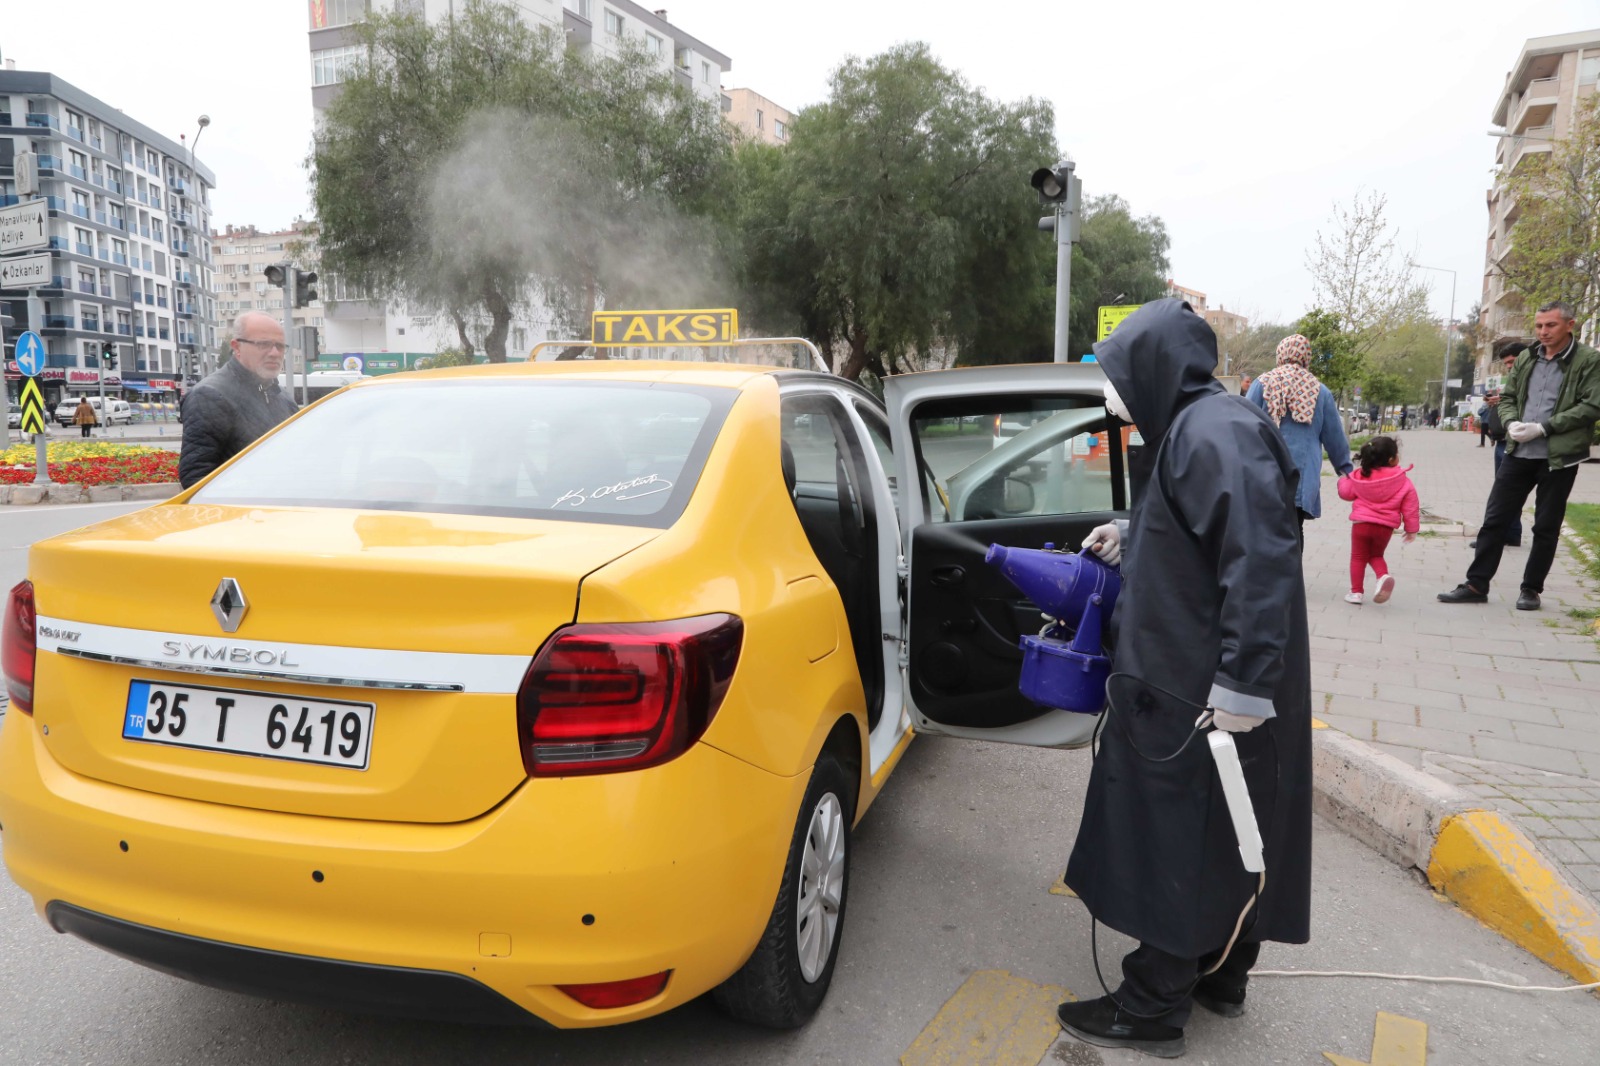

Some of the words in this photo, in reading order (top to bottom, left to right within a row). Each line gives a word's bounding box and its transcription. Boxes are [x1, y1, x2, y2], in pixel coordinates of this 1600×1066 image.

[0, 211, 36, 227] Manavkuyu
[1, 230, 24, 245] Adliye
[162, 640, 299, 668] SYMBOL
[129, 713, 144, 729] TR
[147, 690, 189, 737] 35
[215, 697, 235, 743] T
[266, 703, 362, 759] 6419
